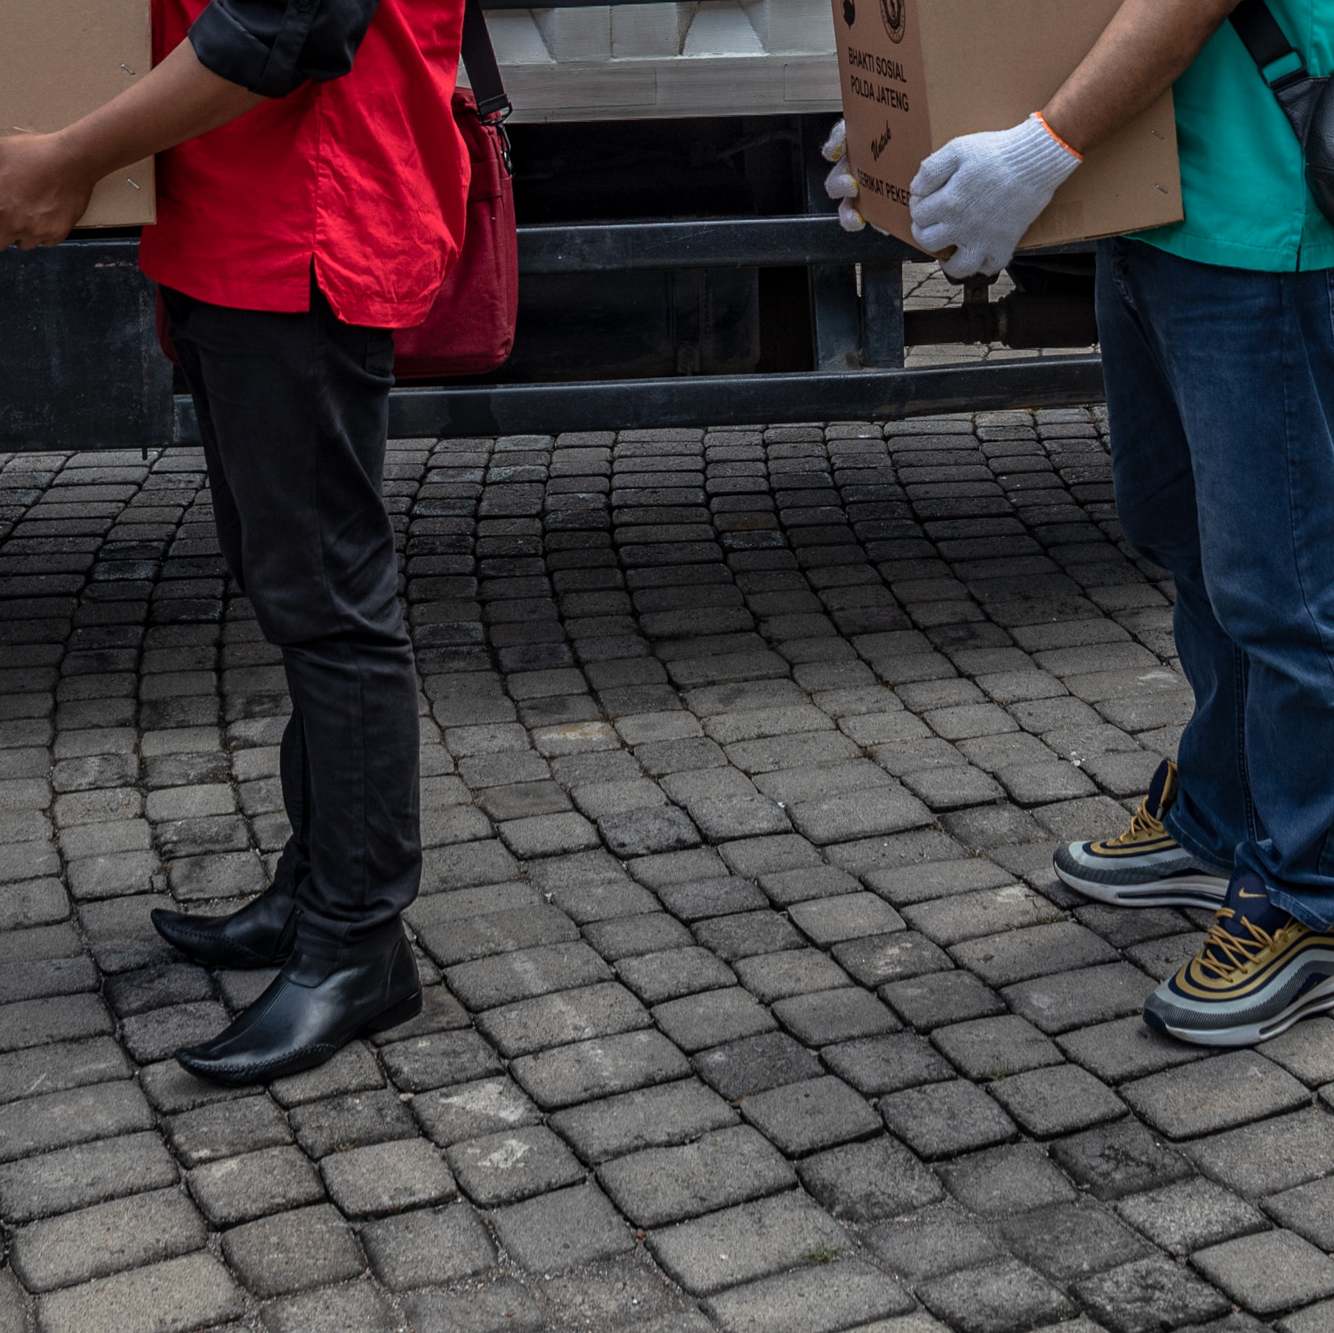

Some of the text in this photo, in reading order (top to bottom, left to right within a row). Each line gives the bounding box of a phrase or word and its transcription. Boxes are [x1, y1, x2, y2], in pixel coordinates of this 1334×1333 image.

[848, 46, 907, 84] BHAKTI SOSIAL
[850, 74, 909, 113] POLDA JATENG
[870, 119, 892, 162] Untuk
[857, 168, 885, 197] SERIKAT
